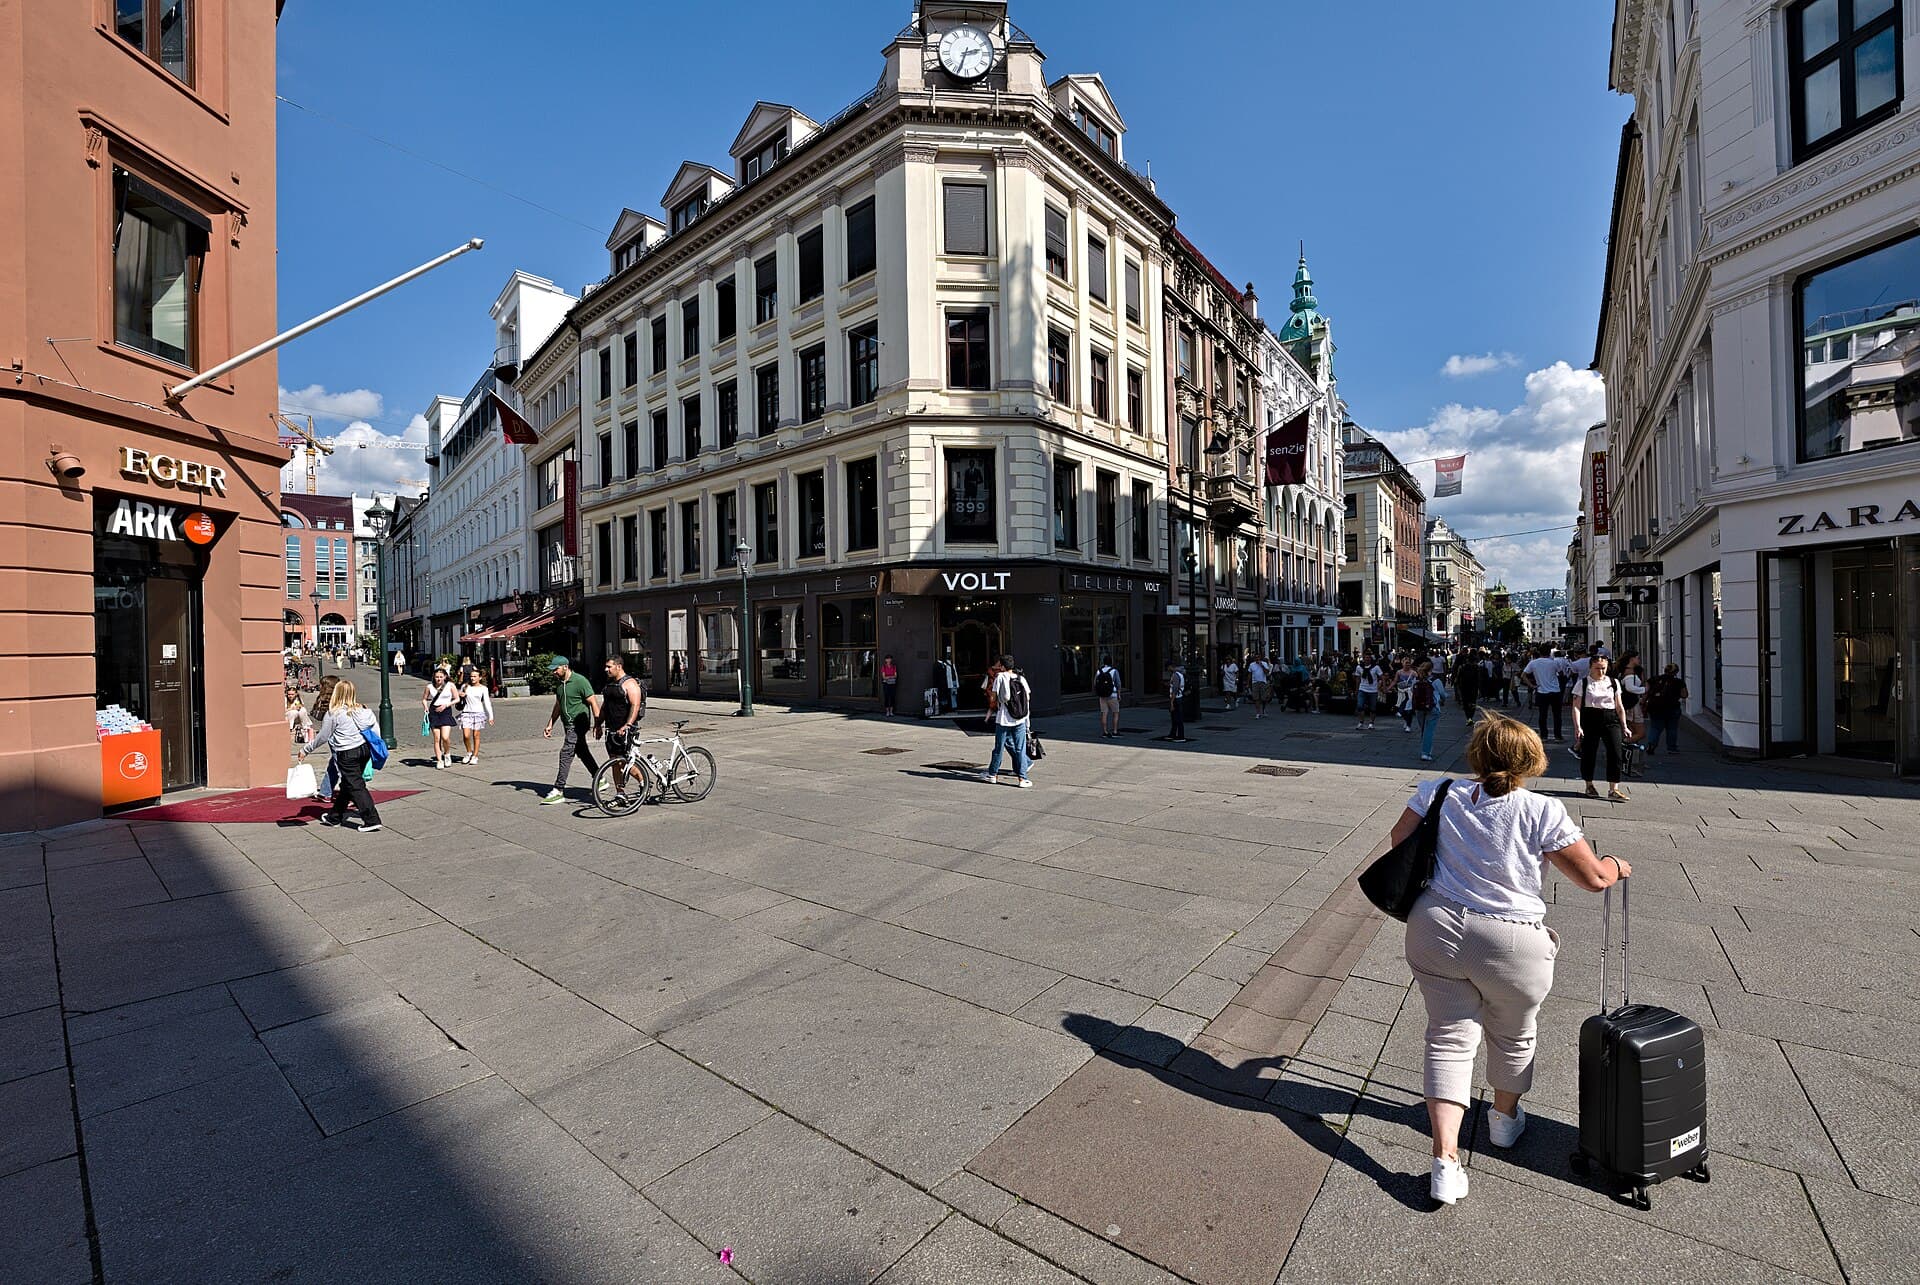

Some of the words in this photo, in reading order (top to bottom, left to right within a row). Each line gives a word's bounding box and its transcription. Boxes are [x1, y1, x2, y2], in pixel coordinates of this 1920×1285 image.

[120, 446, 228, 491] EGER
[956, 502, 985, 513] 899
[109, 498, 177, 542] ARK
[1777, 499, 1920, 536] ZARA
[692, 576, 878, 605] ATLIÉR
[941, 572, 1012, 591] VOLT
[1072, 575, 1133, 591] TELIÉR
[1144, 582, 1161, 592] VOLT
[1678, 1132, 1698, 1148] weber
